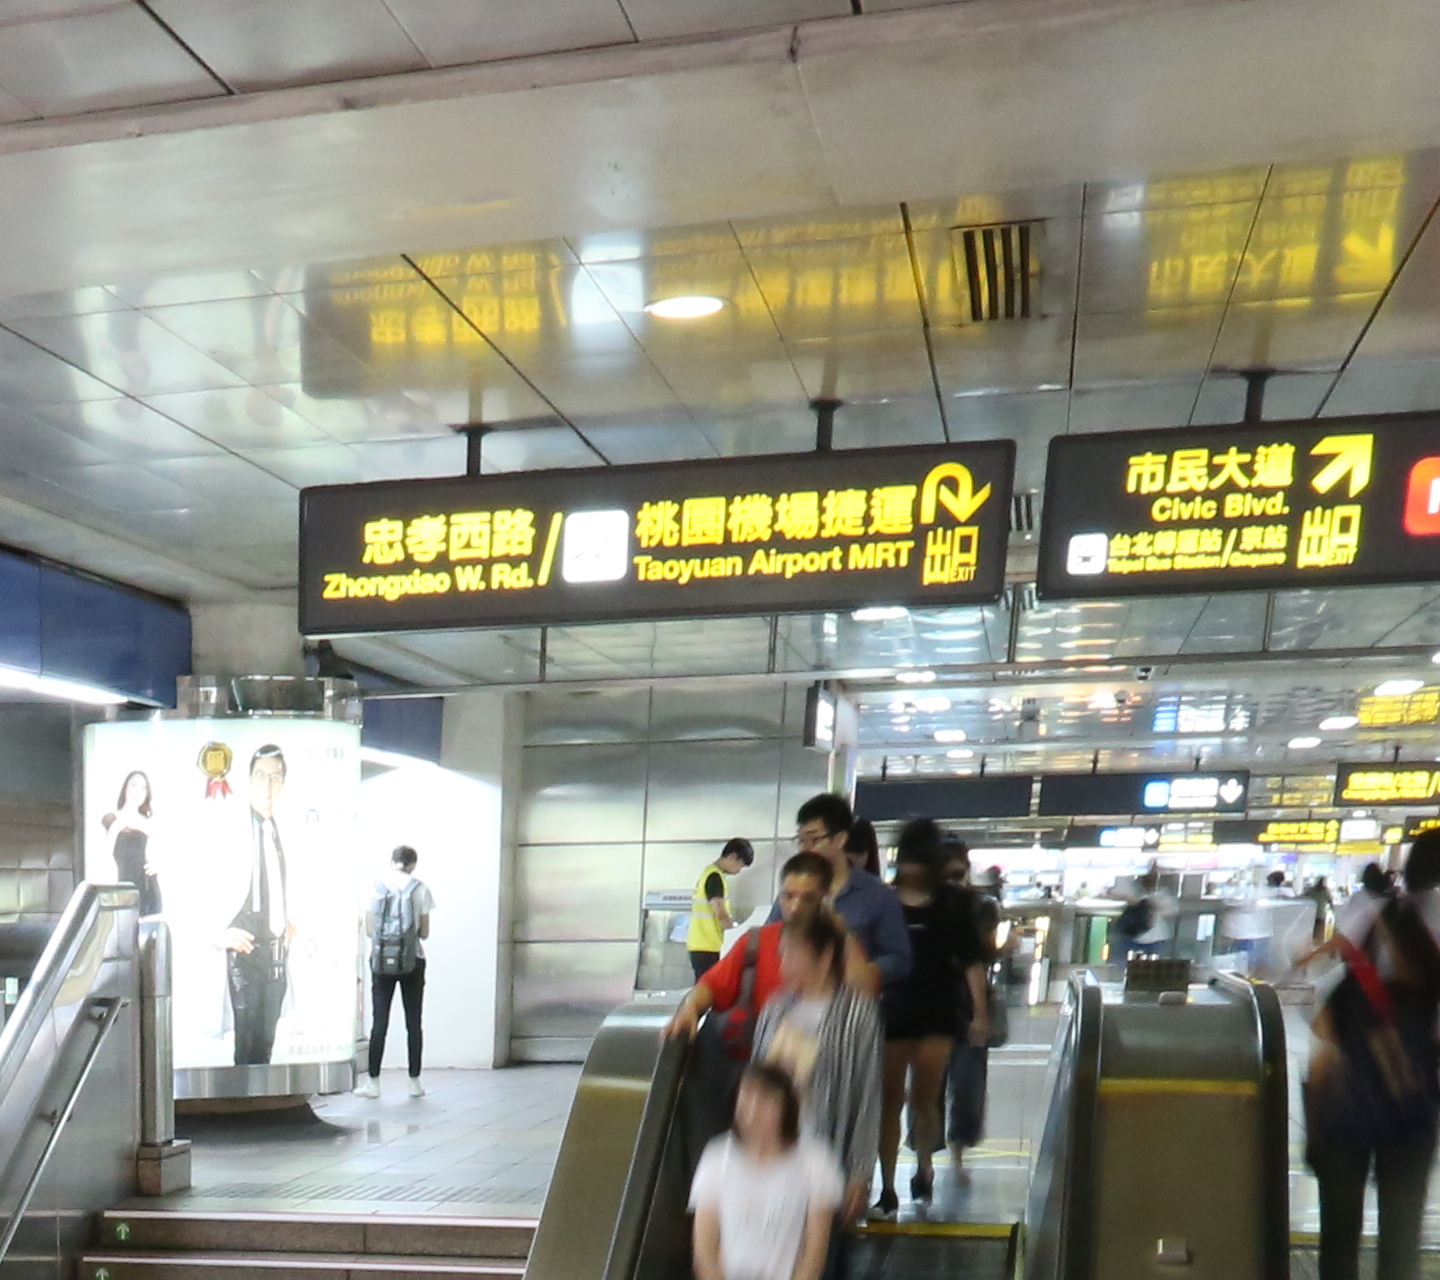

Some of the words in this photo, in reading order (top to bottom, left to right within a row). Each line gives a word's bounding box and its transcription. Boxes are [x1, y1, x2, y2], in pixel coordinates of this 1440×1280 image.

[1126, 442, 1295, 494] 市民大道
[635, 484, 917, 548] 桃園機場捷運
[1150, 495, 1218, 522] Civic
[1224, 491, 1290, 518] Blvd.
[361, 508, 536, 564] 忠孝西路
[923, 525, 979, 585] 出口
[1297, 504, 1361, 568] 出口
[1327, 547, 1358, 566] EXIT
[322, 568, 451, 602] Zhongxiao
[454, 564, 486, 591] W.
[491, 562, 534, 590] Rd.
[634, 553, 743, 584] Taoyuan
[747, 546, 842, 578] Airport
[848, 540, 915, 569] MRT
[951, 564, 976, 582] EXIT
